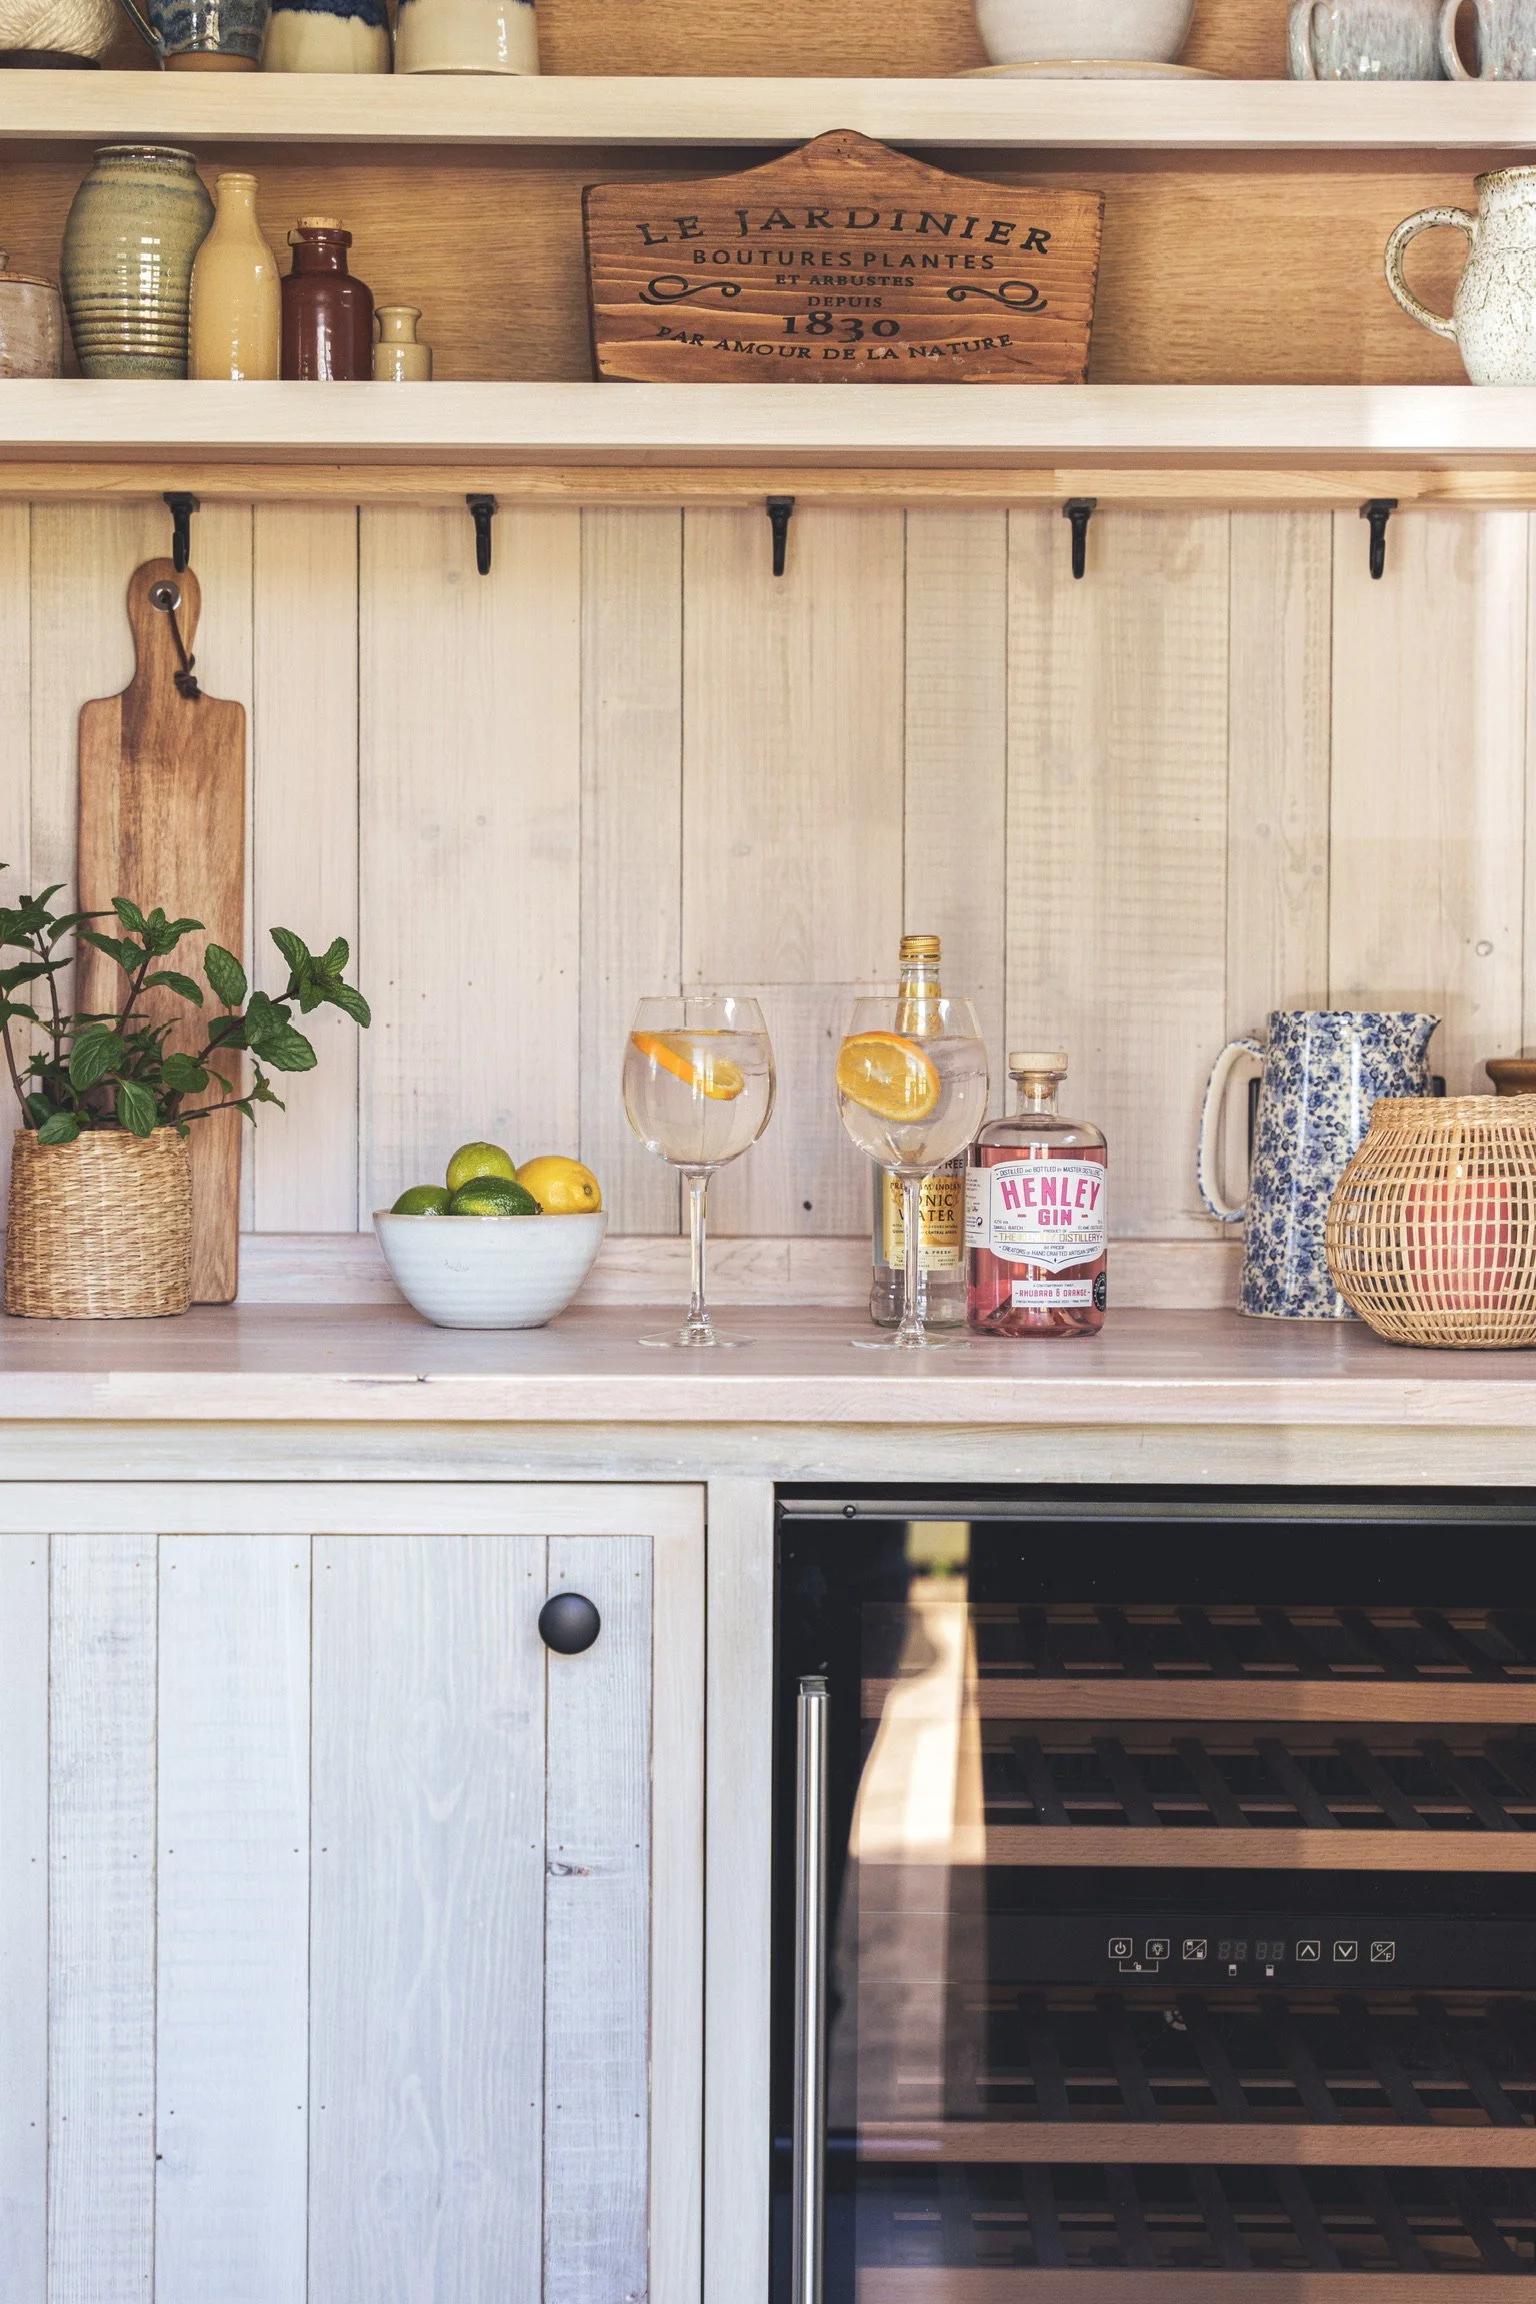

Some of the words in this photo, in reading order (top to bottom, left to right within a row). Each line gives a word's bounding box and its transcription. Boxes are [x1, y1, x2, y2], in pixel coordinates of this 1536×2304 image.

[636, 214, 704, 246] LE
[733, 205, 1052, 255] JARDINIER
[692, 249, 852, 267] BOUTURES
[863, 252, 995, 269] PLANTES
[773, 274, 800, 285] ET
[808, 274, 915, 287] ARBUSTES
[807, 296, 883, 308] DEPUIS
[781, 310, 901, 344] 1830
[656, 326, 705, 347] PAR
[712, 338, 811, 359] AMOUR
[822, 347, 856, 360] DE
[866, 347, 900, 360] LA
[908, 333, 1014, 358] NATURE
[1000, 1167, 1024, 1176] DISTILLED
[1063, 1166, 1081, 1174] MASTER
[1000, 1176, 1100, 1211] HENLEY
[1038, 1208, 1073, 1225] GIN
[999, 1233, 1016, 1241] THE
[1059, 1233, 1101, 1242] DISTILLERY
[1002, 1245, 1026, 1255] CREATORS
[1019, 1289, 1053, 1297] RHUBARB
[1055, 1288, 1060, 1297] &
[1063, 1288, 1087, 1297] ORANGE
